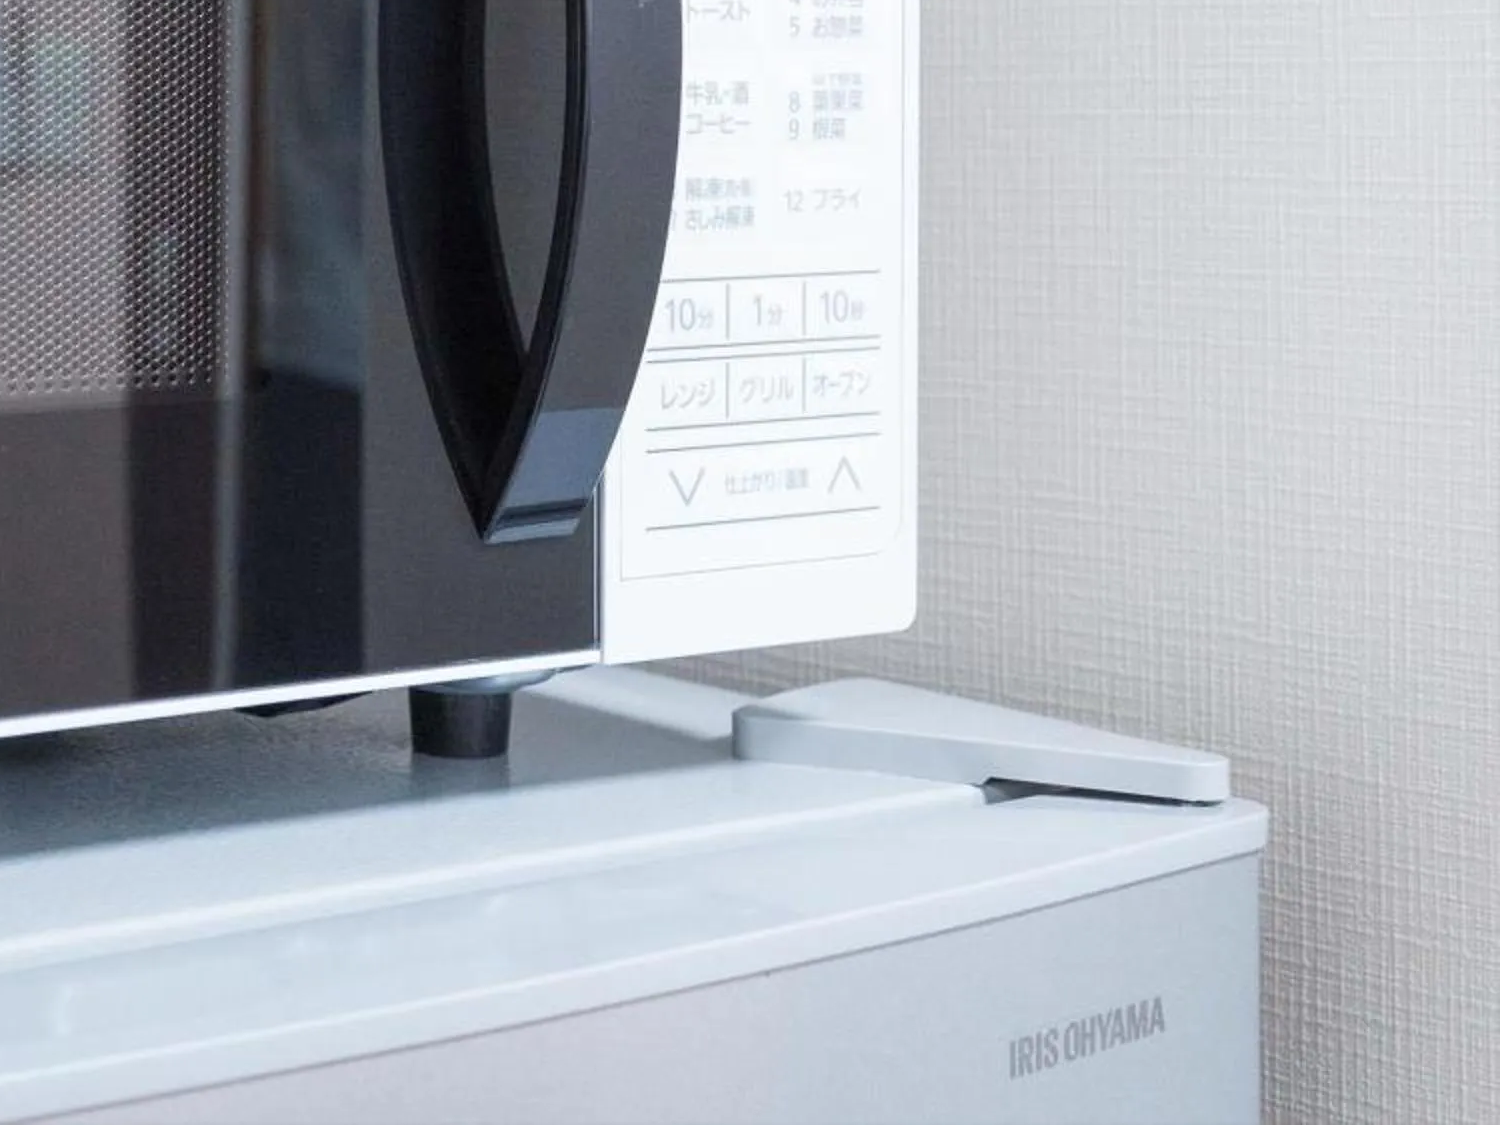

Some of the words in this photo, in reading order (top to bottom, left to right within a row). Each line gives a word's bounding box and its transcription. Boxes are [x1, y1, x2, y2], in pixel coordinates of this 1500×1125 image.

[789, 15, 801, 38] 5
[788, 90, 801, 114] 8
[685, 113, 751, 135] コーヒー
[788, 117, 801, 141] 9
[783, 189, 805, 212] 12
[812, 187, 862, 211] フライ
[660, 377, 716, 410] レンジ
[739, 375, 794, 404] グリル
[1009, 1027, 1060, 1081] IRIS
[1063, 996, 1166, 1061] OHYAMA
